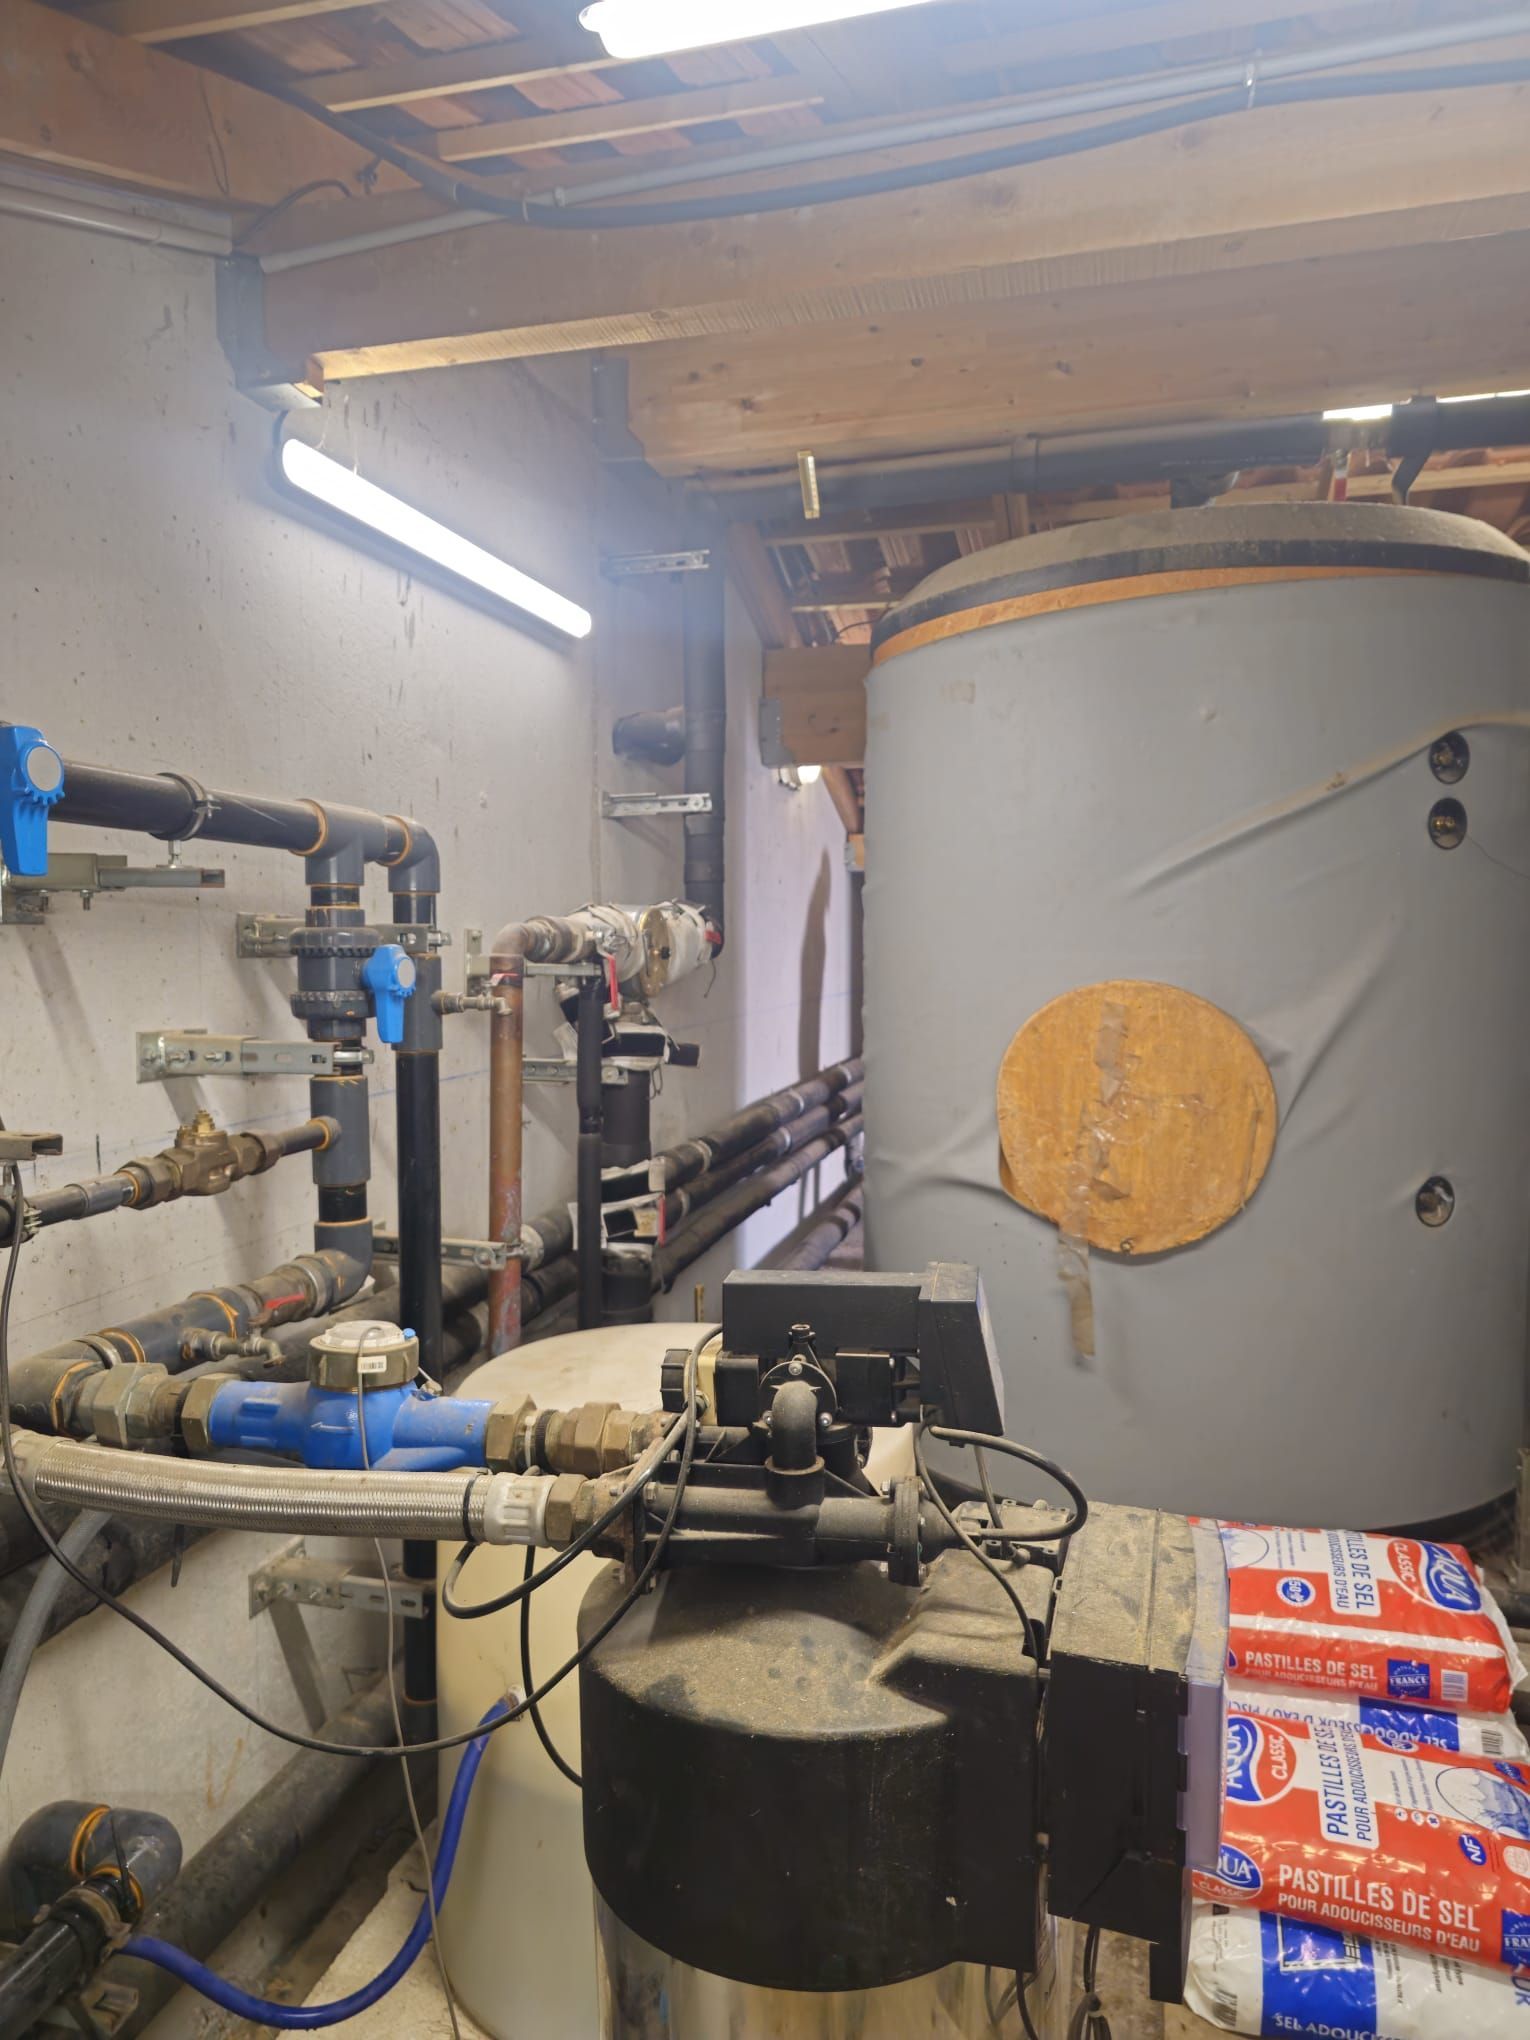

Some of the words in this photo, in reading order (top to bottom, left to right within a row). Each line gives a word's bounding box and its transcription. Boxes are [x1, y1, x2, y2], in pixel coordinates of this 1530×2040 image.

[1351, 1563, 1371, 1579] DE
[1393, 1542, 1416, 1583] CLASSIC
[1430, 1546, 1472, 1604] AQUA
[1334, 1579, 1350, 1608] D'EAU
[1354, 1583, 1375, 1609] SEL
[1245, 1651, 1322, 1673] PASTILLES
[1327, 1660, 1345, 1675] DE
[1350, 1664, 1377, 1680] SEL
[1390, 1675, 1427, 1686] FRANCE
[1314, 1727, 1335, 1739] SE
[1316, 1739, 1338, 1753] DE
[1268, 1734, 1288, 1780] CLASSIC
[1344, 1744, 1367, 1804] ADOUCISSEURS
[1320, 1754, 1348, 1836] PASTILLES
[1354, 1806, 1372, 1841] POUR
[1461, 1834, 1482, 1862] NF
[1217, 1854, 1252, 1880] UA
[1279, 1864, 1394, 1911] PASTILLES
[1402, 1890, 1431, 1920] DE
[1438, 1900, 1481, 1932] SEL
[1278, 1893, 1317, 1913] POUR
[1320, 1902, 1432, 1940] ADOUCISSEURS
[1436, 1930, 1480, 1952] D'EAU
[1275, 2014, 1301, 2031] SEL
